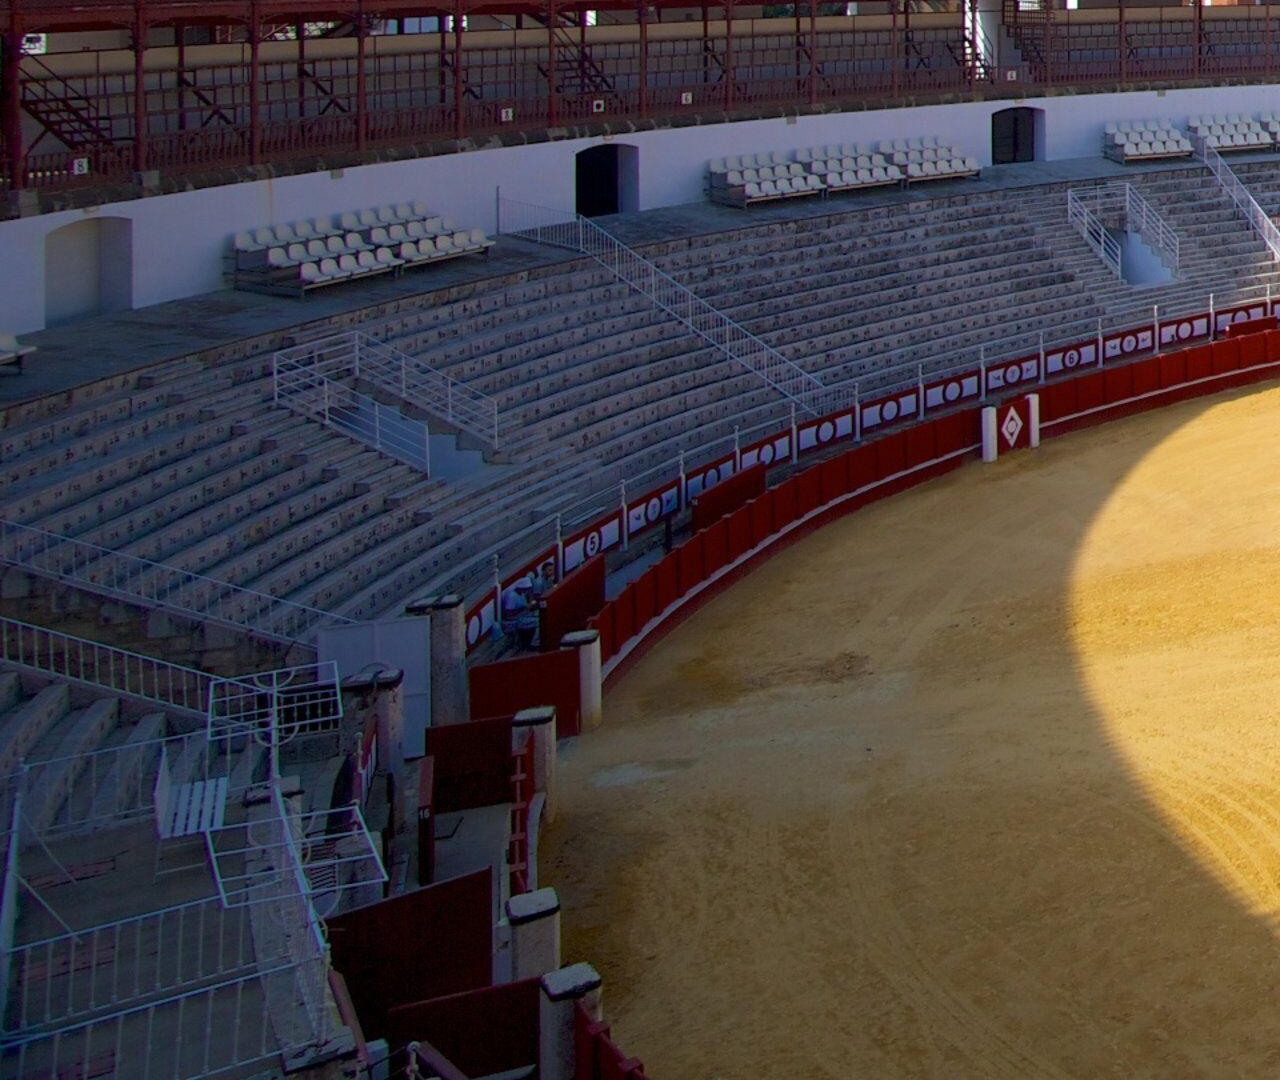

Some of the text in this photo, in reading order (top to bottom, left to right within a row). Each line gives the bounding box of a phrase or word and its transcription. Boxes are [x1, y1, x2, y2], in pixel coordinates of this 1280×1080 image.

[1068, 353, 1076, 366] 6
[589, 535, 597, 552] 5
[420, 807, 430, 819] 16
